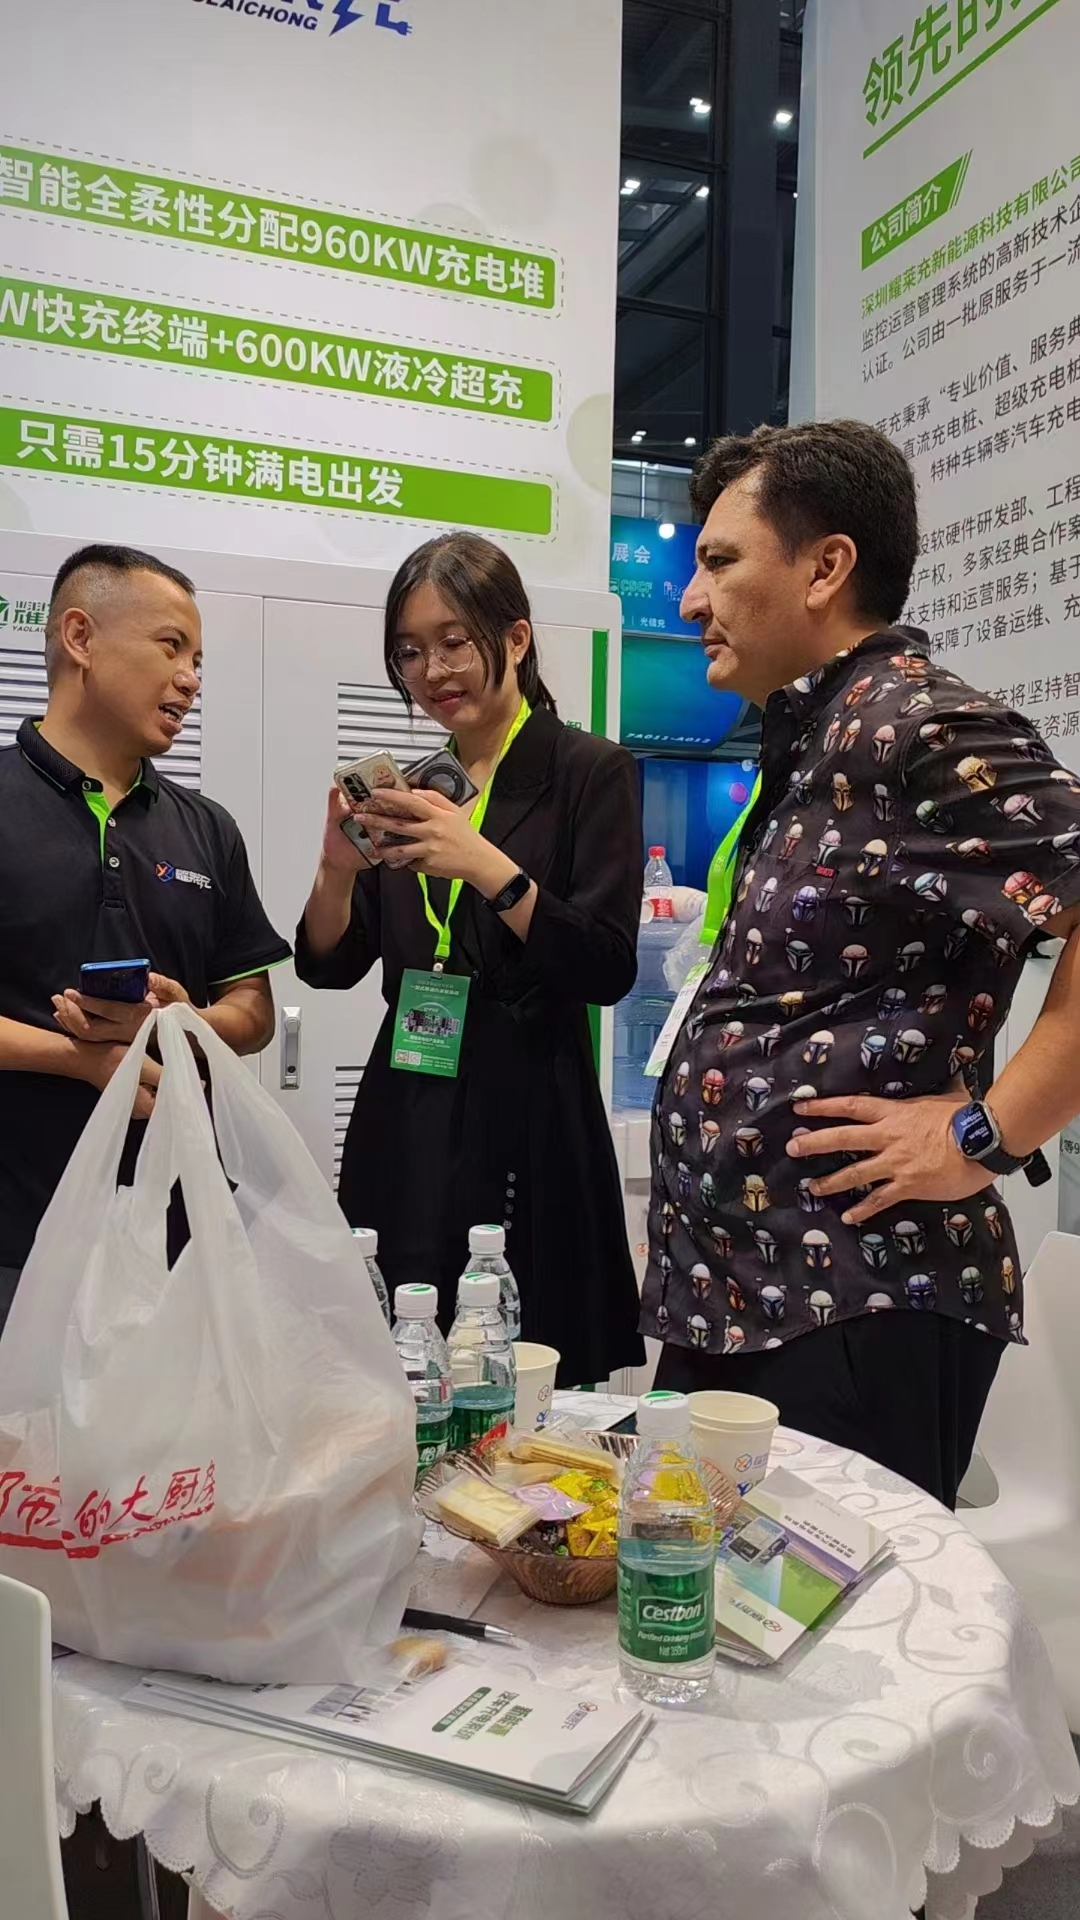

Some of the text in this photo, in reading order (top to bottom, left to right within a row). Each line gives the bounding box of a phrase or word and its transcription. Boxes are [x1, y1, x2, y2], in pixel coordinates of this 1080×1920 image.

[193, 0, 318, 31] LAICHONG
[863, 0, 1021, 127] 领先的
[0, 154, 546, 300] 智能全柔性分配960KW充电堆
[861, 154, 1080, 319] 深圳耀莱充新能源科技有限公司
[870, 183, 942, 254] 公司简介
[16, 419, 403, 508] 只需15分钟满电出发
[612, 543, 651, 564] 展会
[13, 600, 50, 625] 耀
[984, 672, 1080, 708] 充将坚持智
